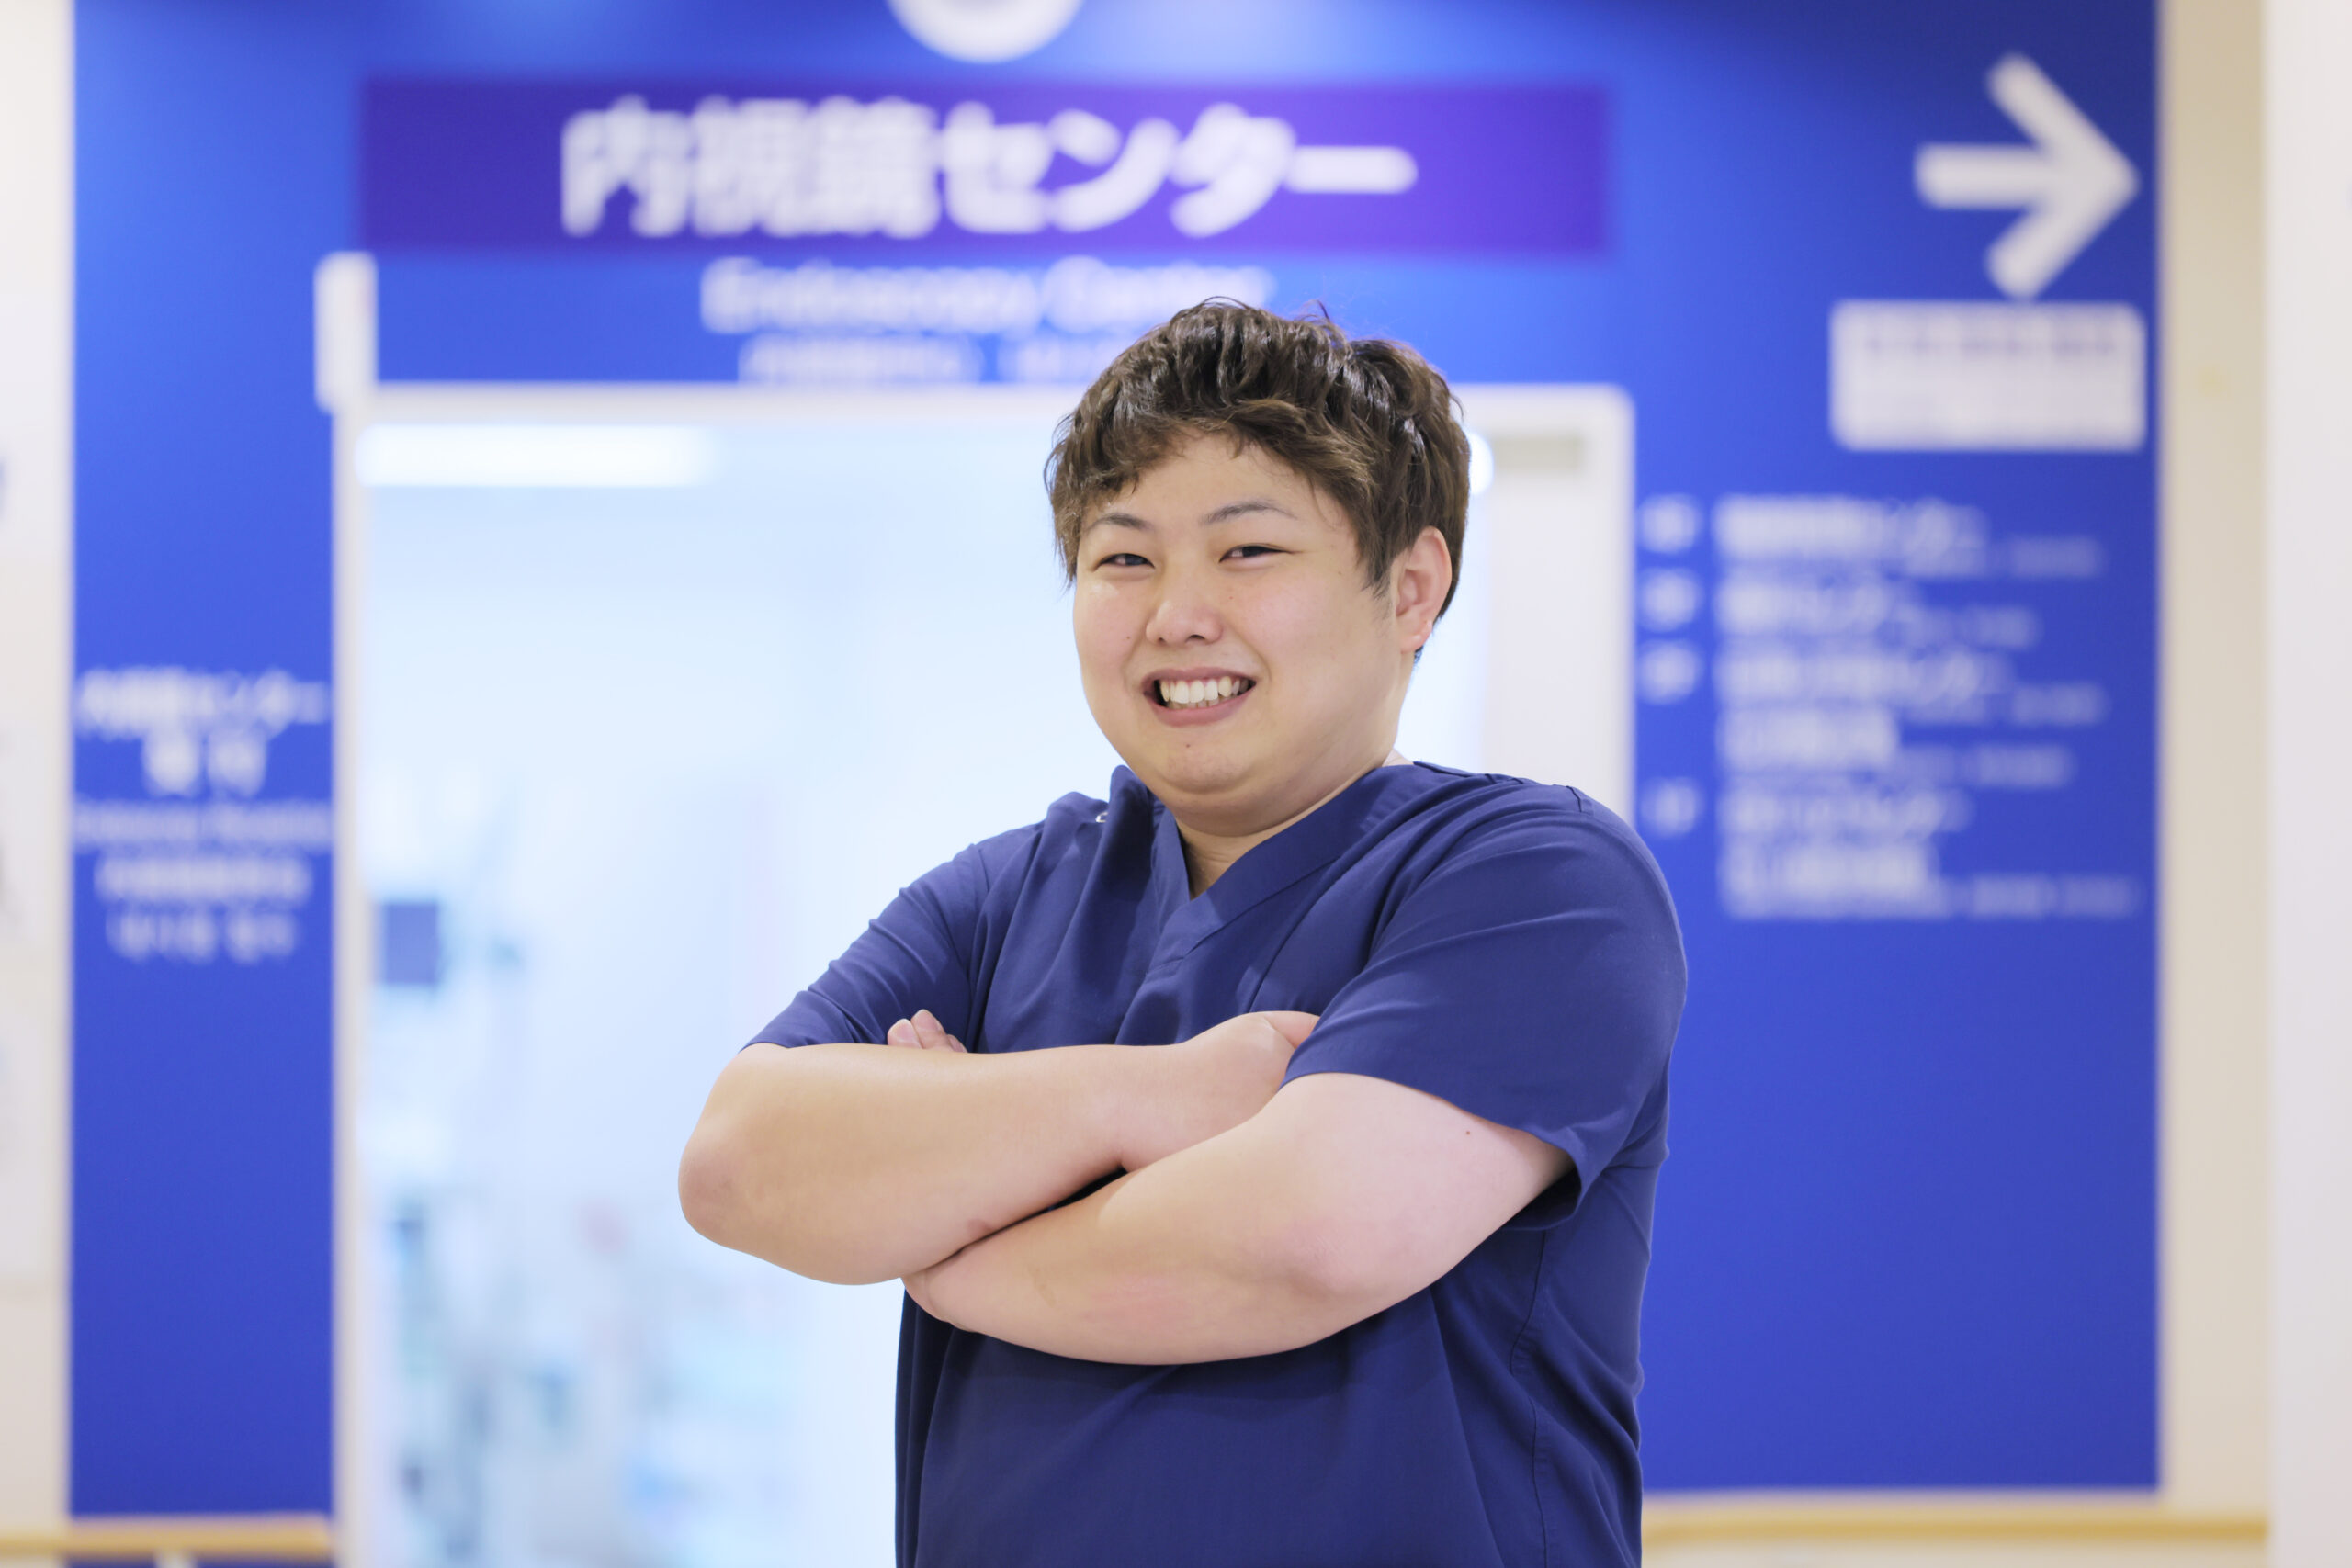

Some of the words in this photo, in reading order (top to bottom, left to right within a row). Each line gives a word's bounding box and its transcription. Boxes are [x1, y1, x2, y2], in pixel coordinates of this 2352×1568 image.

[562, 96, 1418, 237] 内視鏡センター
